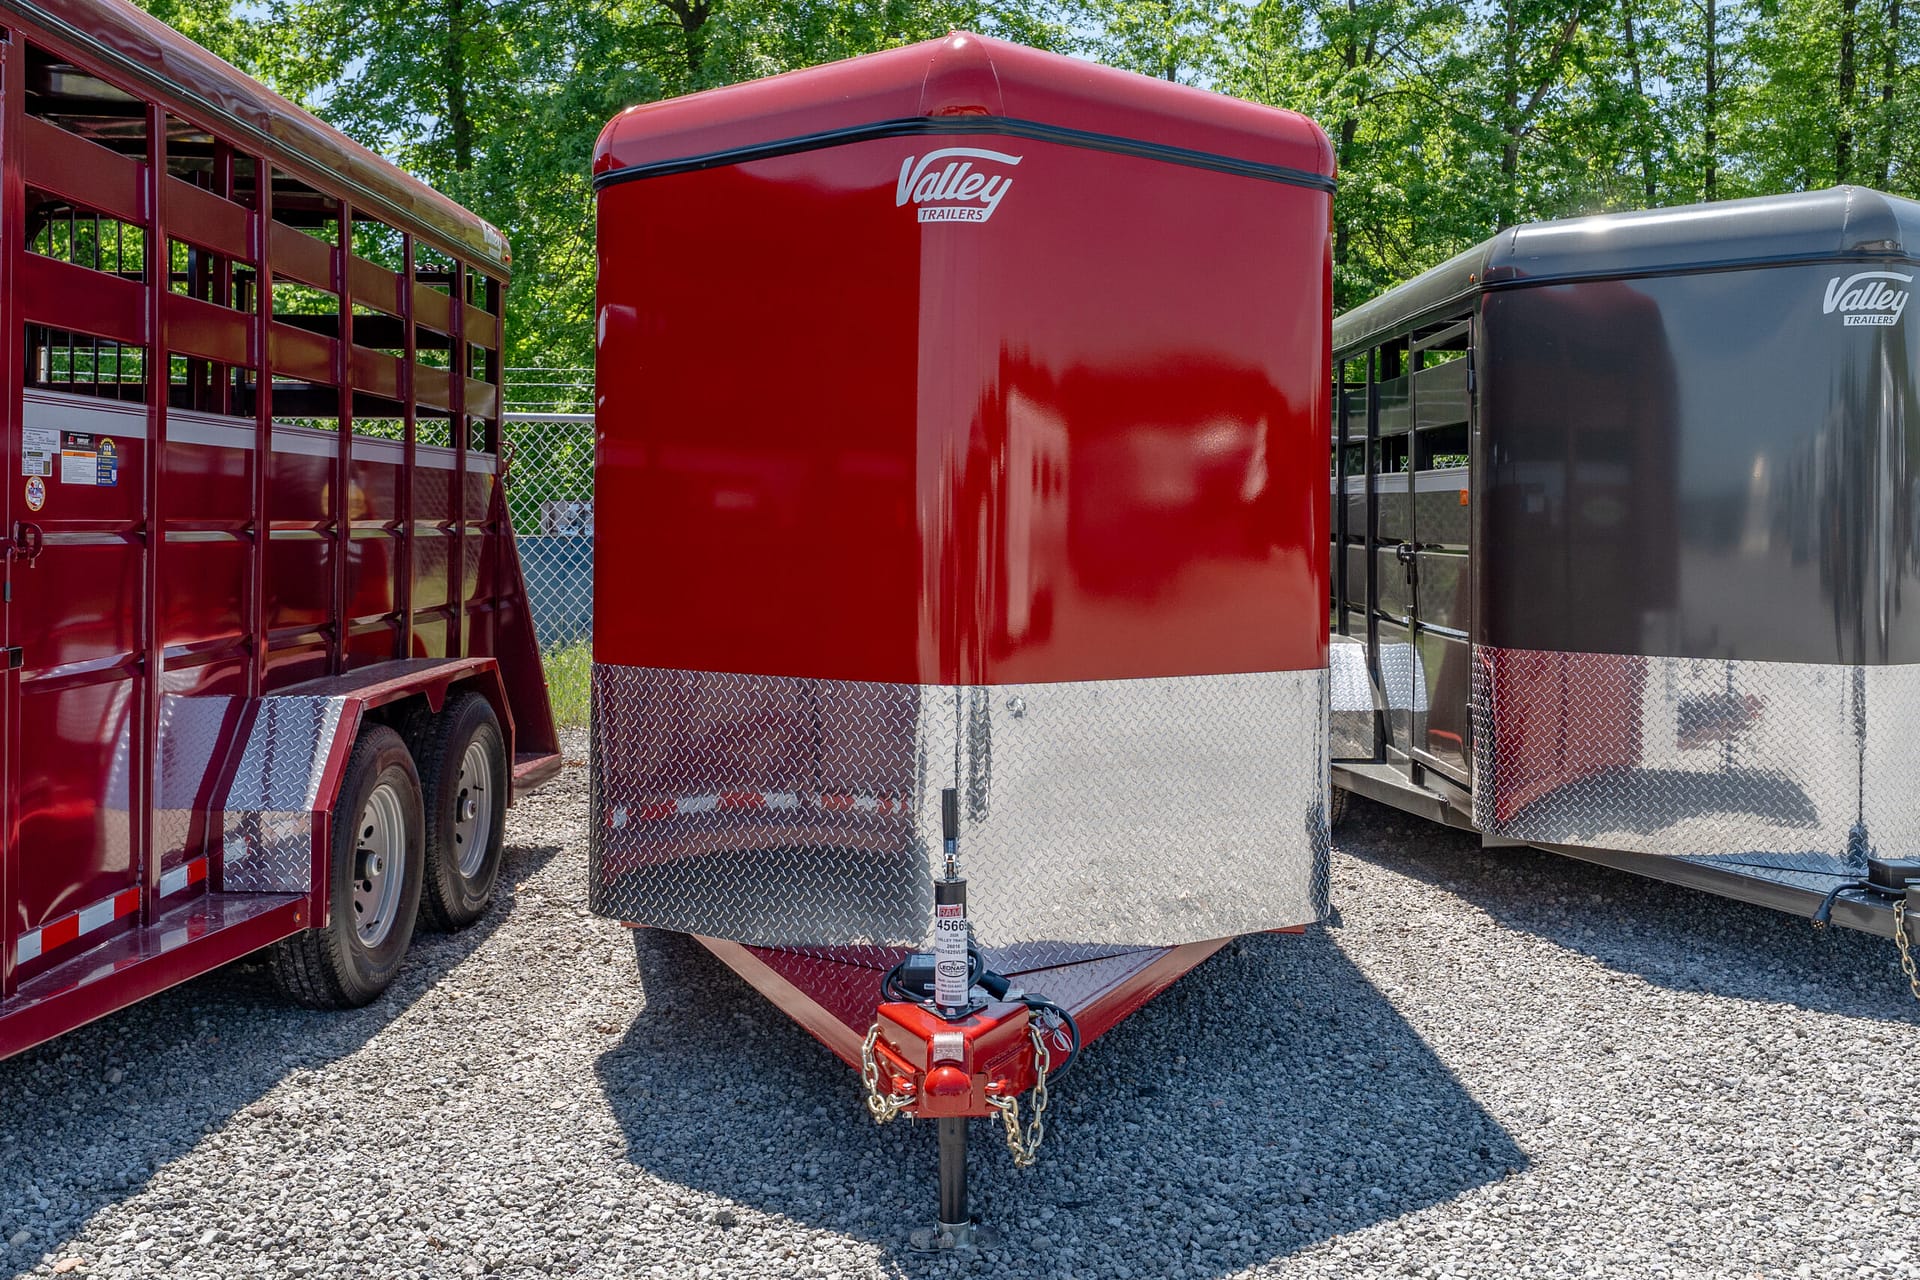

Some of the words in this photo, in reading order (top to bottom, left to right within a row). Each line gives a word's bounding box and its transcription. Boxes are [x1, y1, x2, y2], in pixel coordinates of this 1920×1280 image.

[896, 147, 1023, 215] Valley
[921, 208, 984, 221] TRAILERS
[1823, 271, 1914, 318] Valley
[1847, 315, 1895, 325] TRAILERS
[939, 908, 961, 918] RAM
